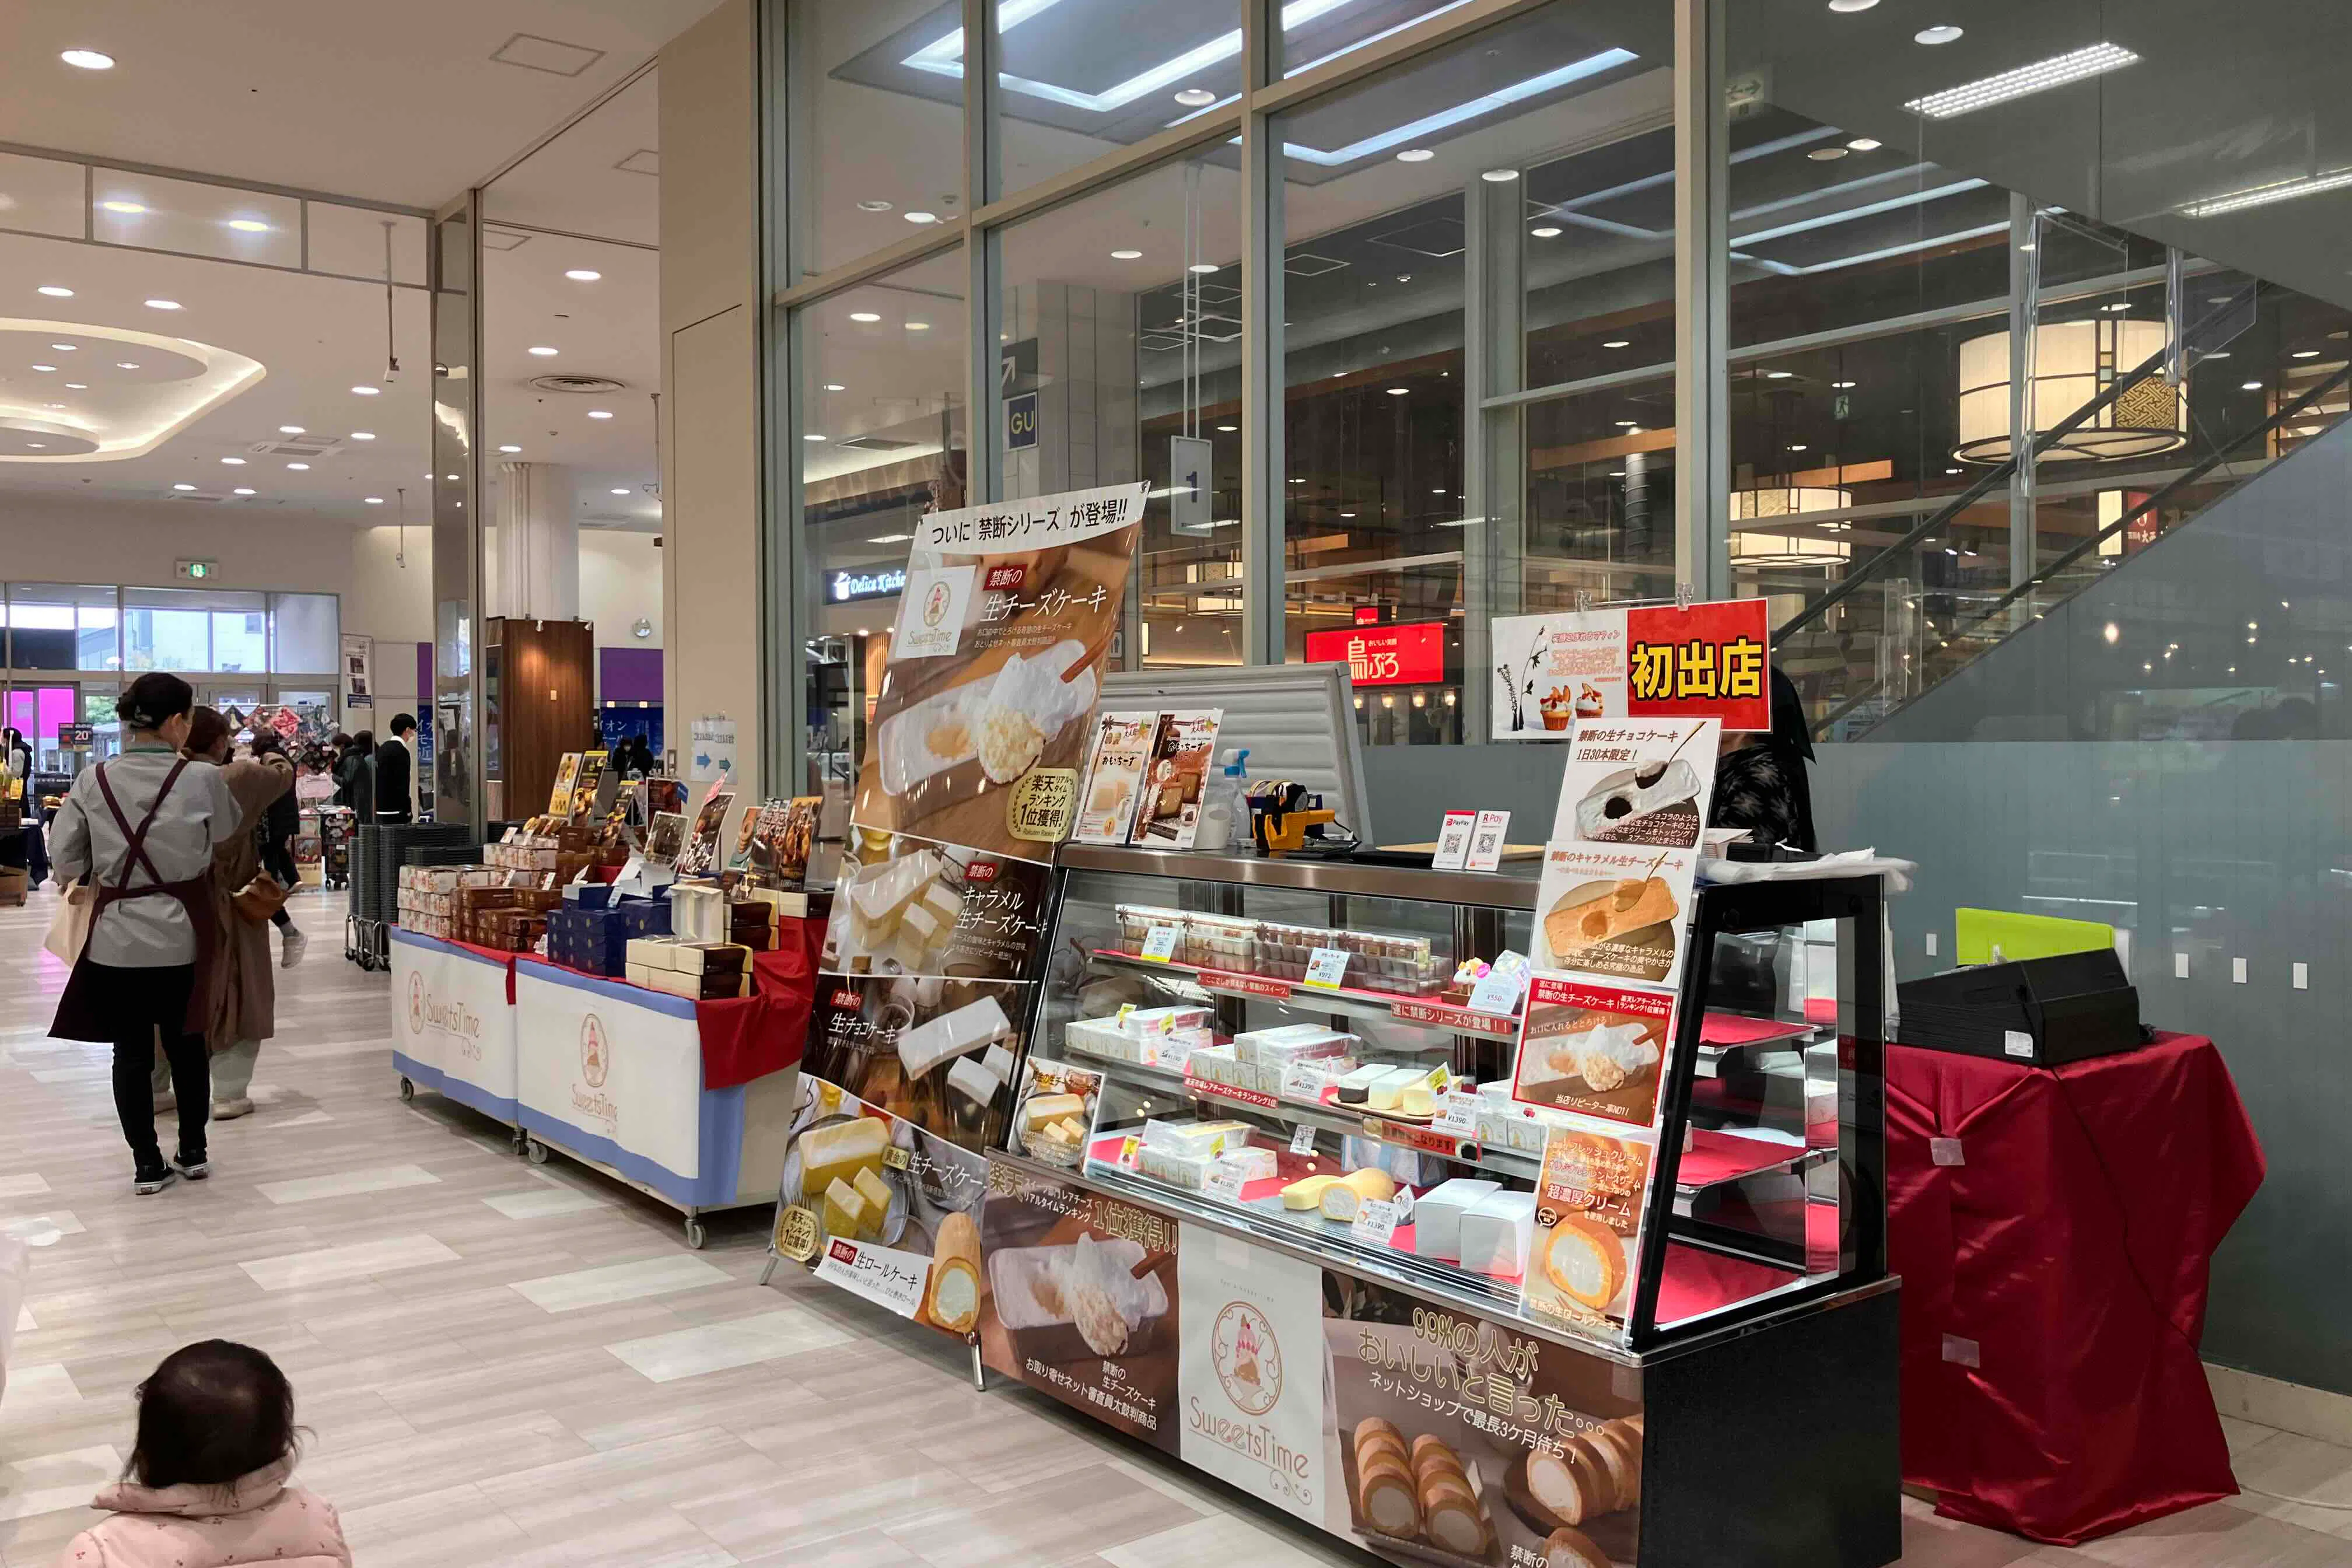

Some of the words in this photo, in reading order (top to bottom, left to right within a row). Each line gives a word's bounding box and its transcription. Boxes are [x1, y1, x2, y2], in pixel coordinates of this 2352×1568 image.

[1011, 410, 1034, 434] GU
[1186, 471, 1198, 503] 1
[877, 570, 906, 593] Kitche
[989, 569, 1023, 587] 禁断の
[979, 585, 1107, 622] 生チーズケーキ
[1348, 636, 1399, 680] 鳥ぷろ
[1631, 638, 1763, 699] 初出店
[1577, 729, 1678, 743] 禁断の生チョコケーキ
[1031, 775, 1055, 792] 楽天
[1028, 794, 1067, 808] ランキング
[968, 864, 993, 878] 禁断の
[963, 886, 1025, 910] キャラメル
[834, 992, 860, 1006] 禁断の
[828, 1013, 896, 1045] 生チョコケーキ
[908, 1151, 988, 1189] 生チーズケー
[989, 1160, 1023, 1203] 楽天
[1023, 1191, 1091, 1223] リアルタイムランキング
[1546, 1184, 1631, 1217] 超濃厚クリーム
[832, 1243, 855, 1261] 禁断の
[854, 1251, 918, 1291] 生ロールケーキ
[1412, 1307, 1540, 1374] 99%の人が
[1101, 1360, 1126, 1381] 禁断の
[1025, 1356, 1157, 1431] お取り寄せネット審査員太鼓判商品
[1101, 1376, 1157, 1410] 生チーズケーキ
[1189, 1396, 1309, 1479] SweetsTime
[1510, 1544, 1549, 1568] 禁断の
